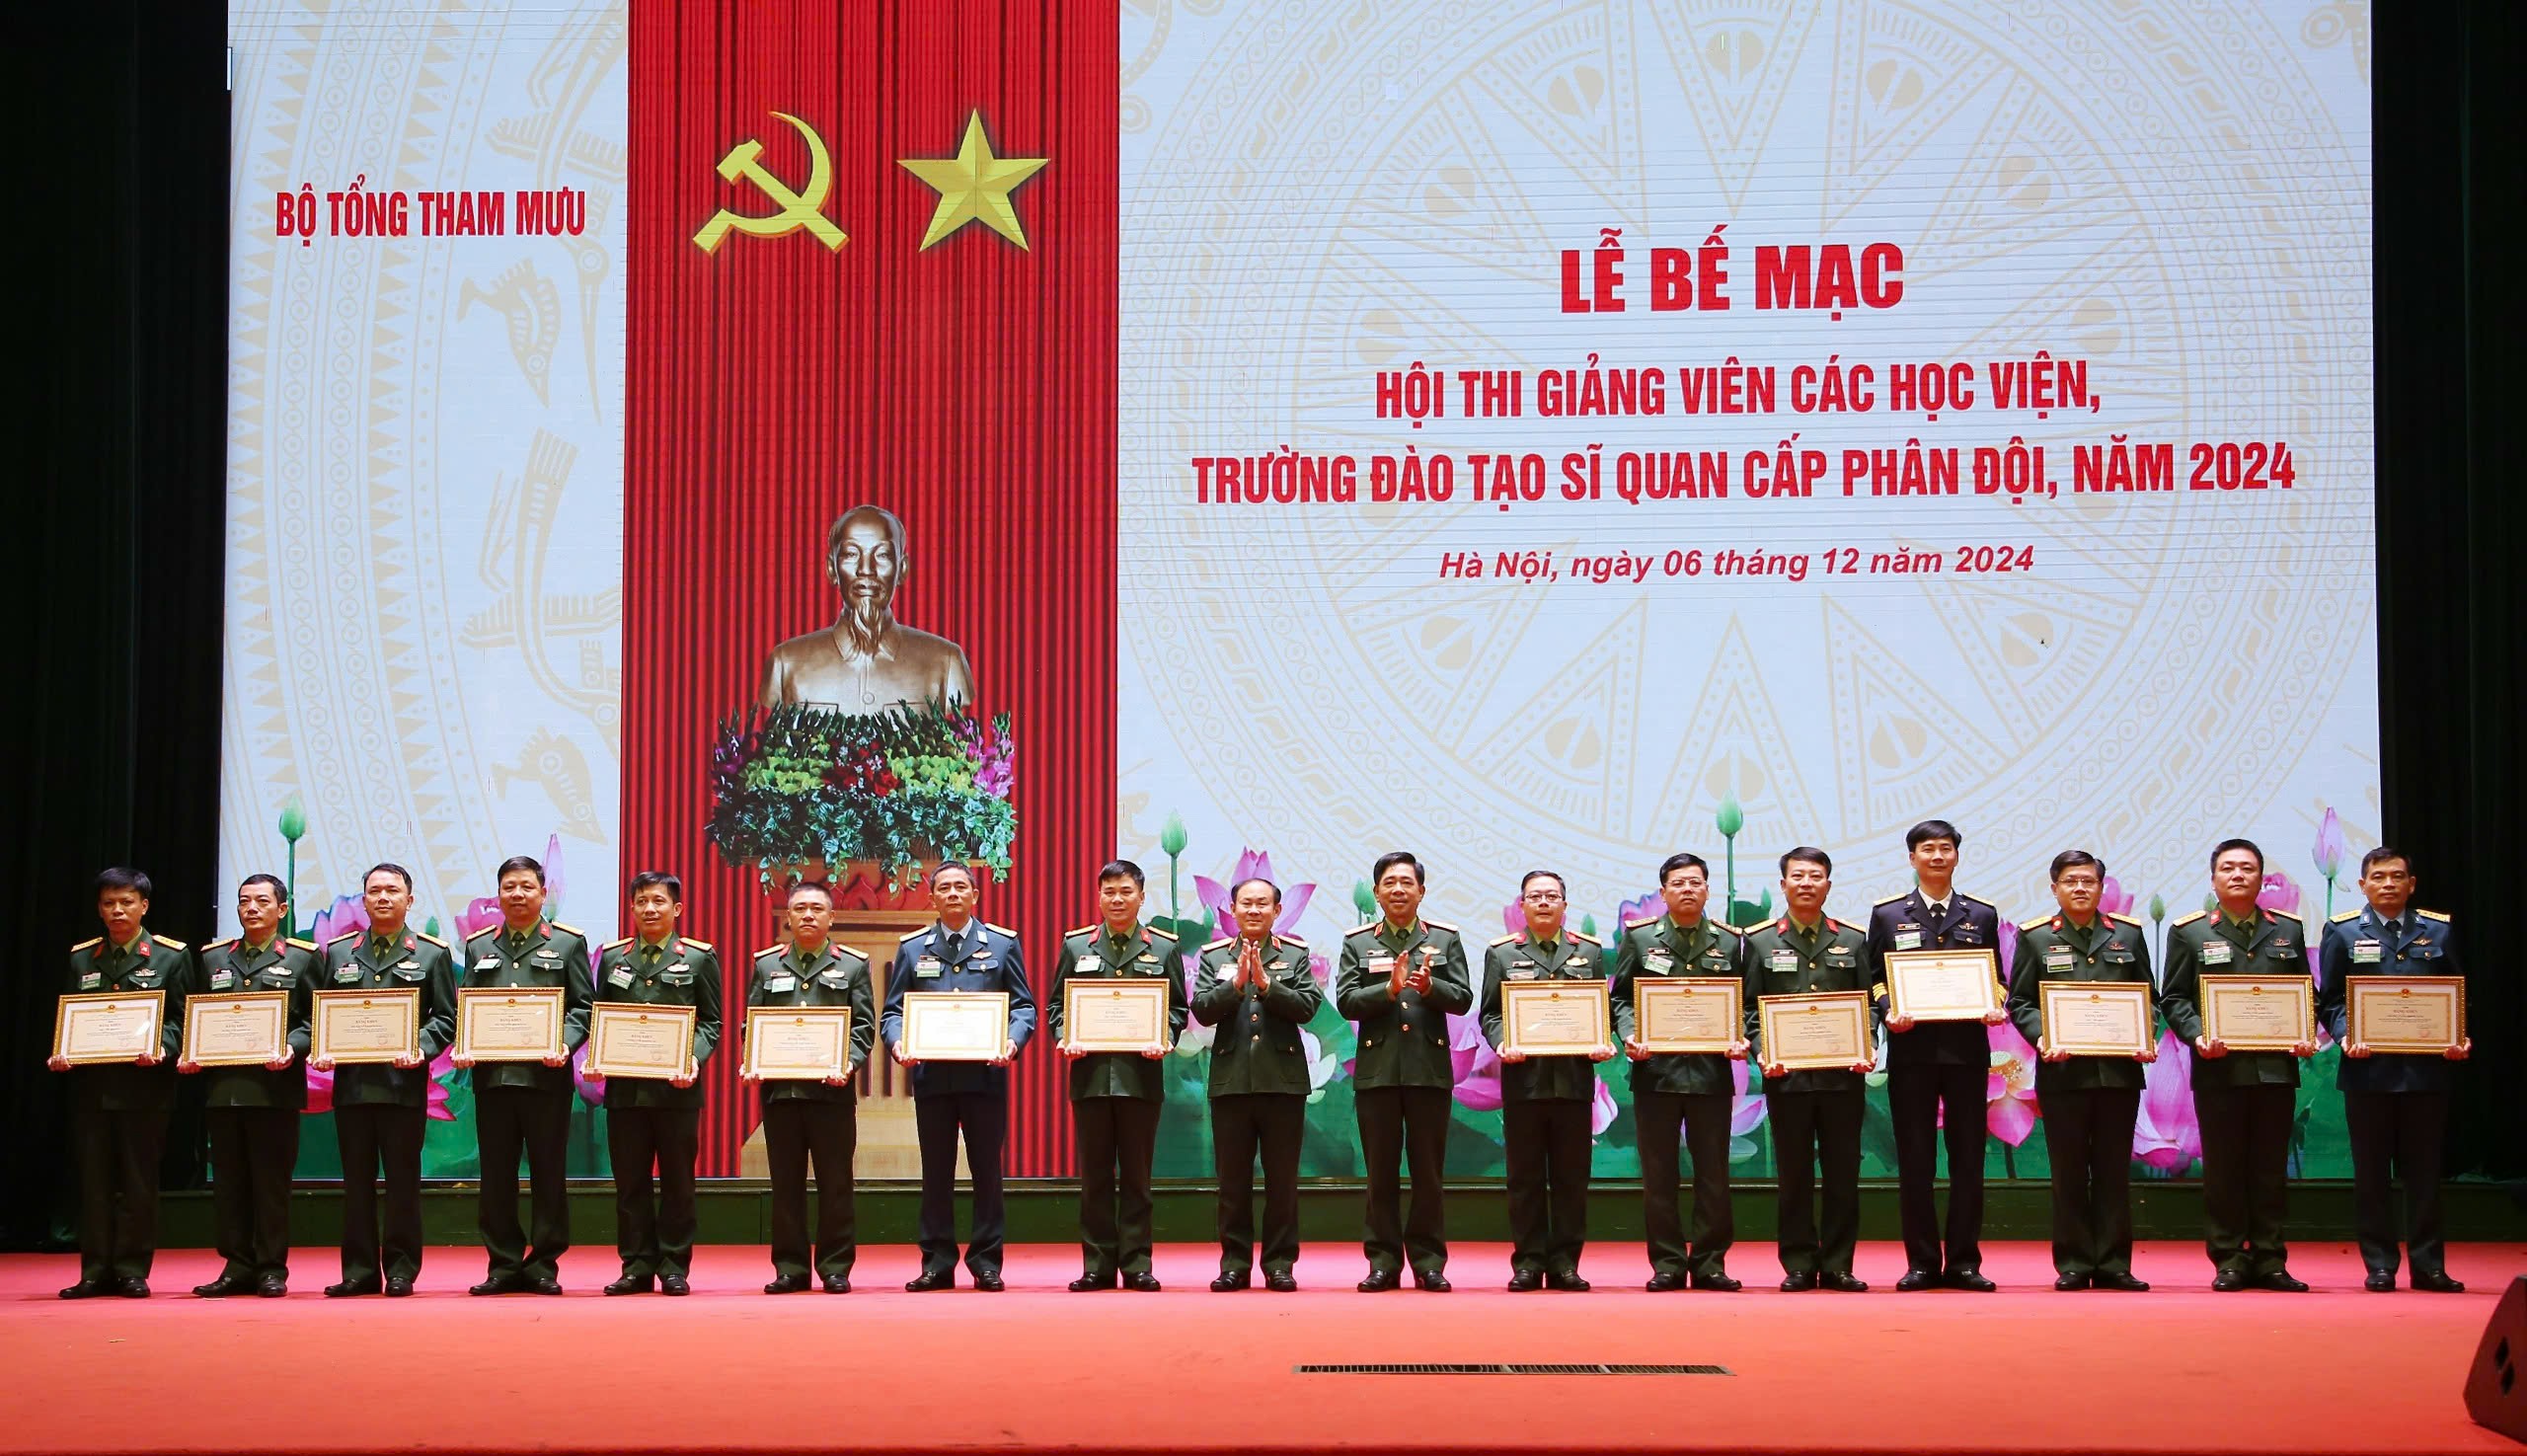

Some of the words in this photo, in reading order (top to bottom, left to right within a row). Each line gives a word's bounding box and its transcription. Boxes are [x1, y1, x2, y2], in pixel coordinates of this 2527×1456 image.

[276, 183, 316, 247] BỘ
[327, 174, 408, 237] TỔNG
[419, 191, 504, 236] THAM
[516, 186, 585, 236] MƯU
[1562, 228, 1625, 313] LỄ
[1650, 225, 1730, 311] BẾ
[1755, 243, 1903, 321] MẠC
[1376, 361, 1444, 428] HỘI
[1458, 371, 1521, 418] THI
[1538, 352, 1664, 417] GIẢNG
[1680, 356, 1775, 415] VIÊN
[1792, 354, 1875, 413] CÁC
[1890, 362, 1974, 421] HỌC
[1989, 350, 2100, 420] VIỆN,
[1192, 445, 1356, 503] TRƯỜNG
[1370, 445, 1453, 502] ĐÀO
[1468, 454, 1546, 511] TẠO
[1562, 444, 1602, 500] SĨ
[1617, 451, 1727, 504] QUAN
[1744, 433, 1827, 498] CẤP
[1843, 438, 1958, 497] PHÂN
[1973, 436, 2057, 504] ĐỘI,
[2074, 435, 2174, 493] NĂM
[2190, 442, 2296, 491] 2024
[1440, 552, 1483, 578] Hà
[1495, 551, 1557, 583] Nội,
[1571, 551, 1652, 583] ngày
[1664, 550, 1702, 575] 06
[1715, 550, 1808, 581] tháng
[1823, 548, 1859, 574] 12
[1872, 549, 1942, 573] năm
[1955, 545, 2033, 572] 2024
